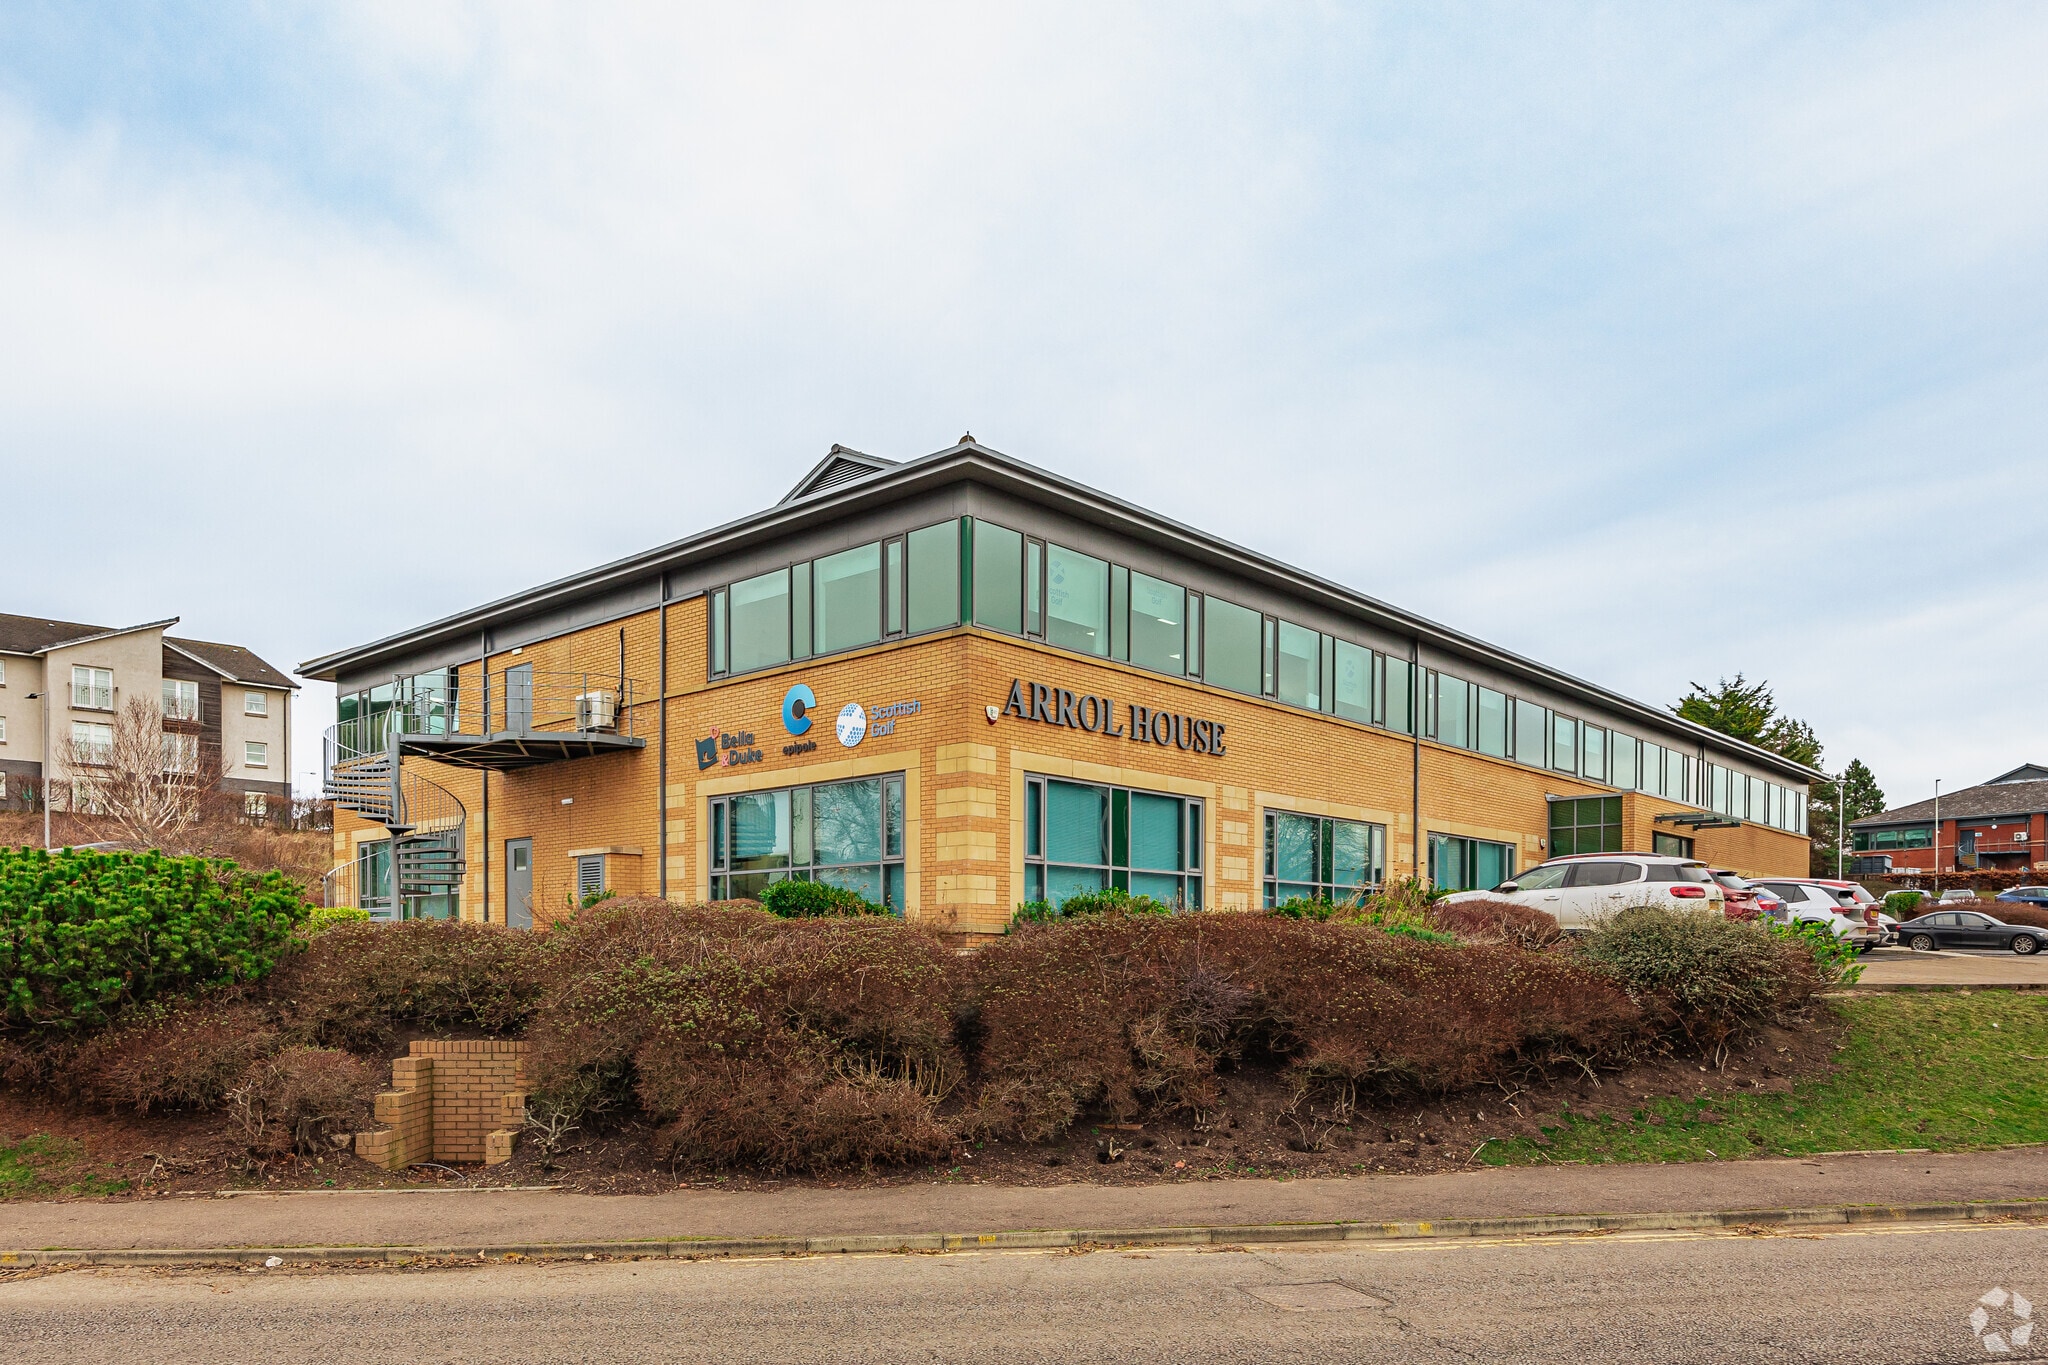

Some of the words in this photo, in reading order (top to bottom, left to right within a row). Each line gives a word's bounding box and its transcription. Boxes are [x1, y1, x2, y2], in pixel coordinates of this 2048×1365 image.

[871, 698, 921, 720] Scottish
[1003, 678, 1123, 737] ARROL
[1129, 704, 1226, 756] HOUSE
[871, 719, 895, 737] Golf
[721, 731, 755, 749] Bella
[783, 740, 817, 756] epipole
